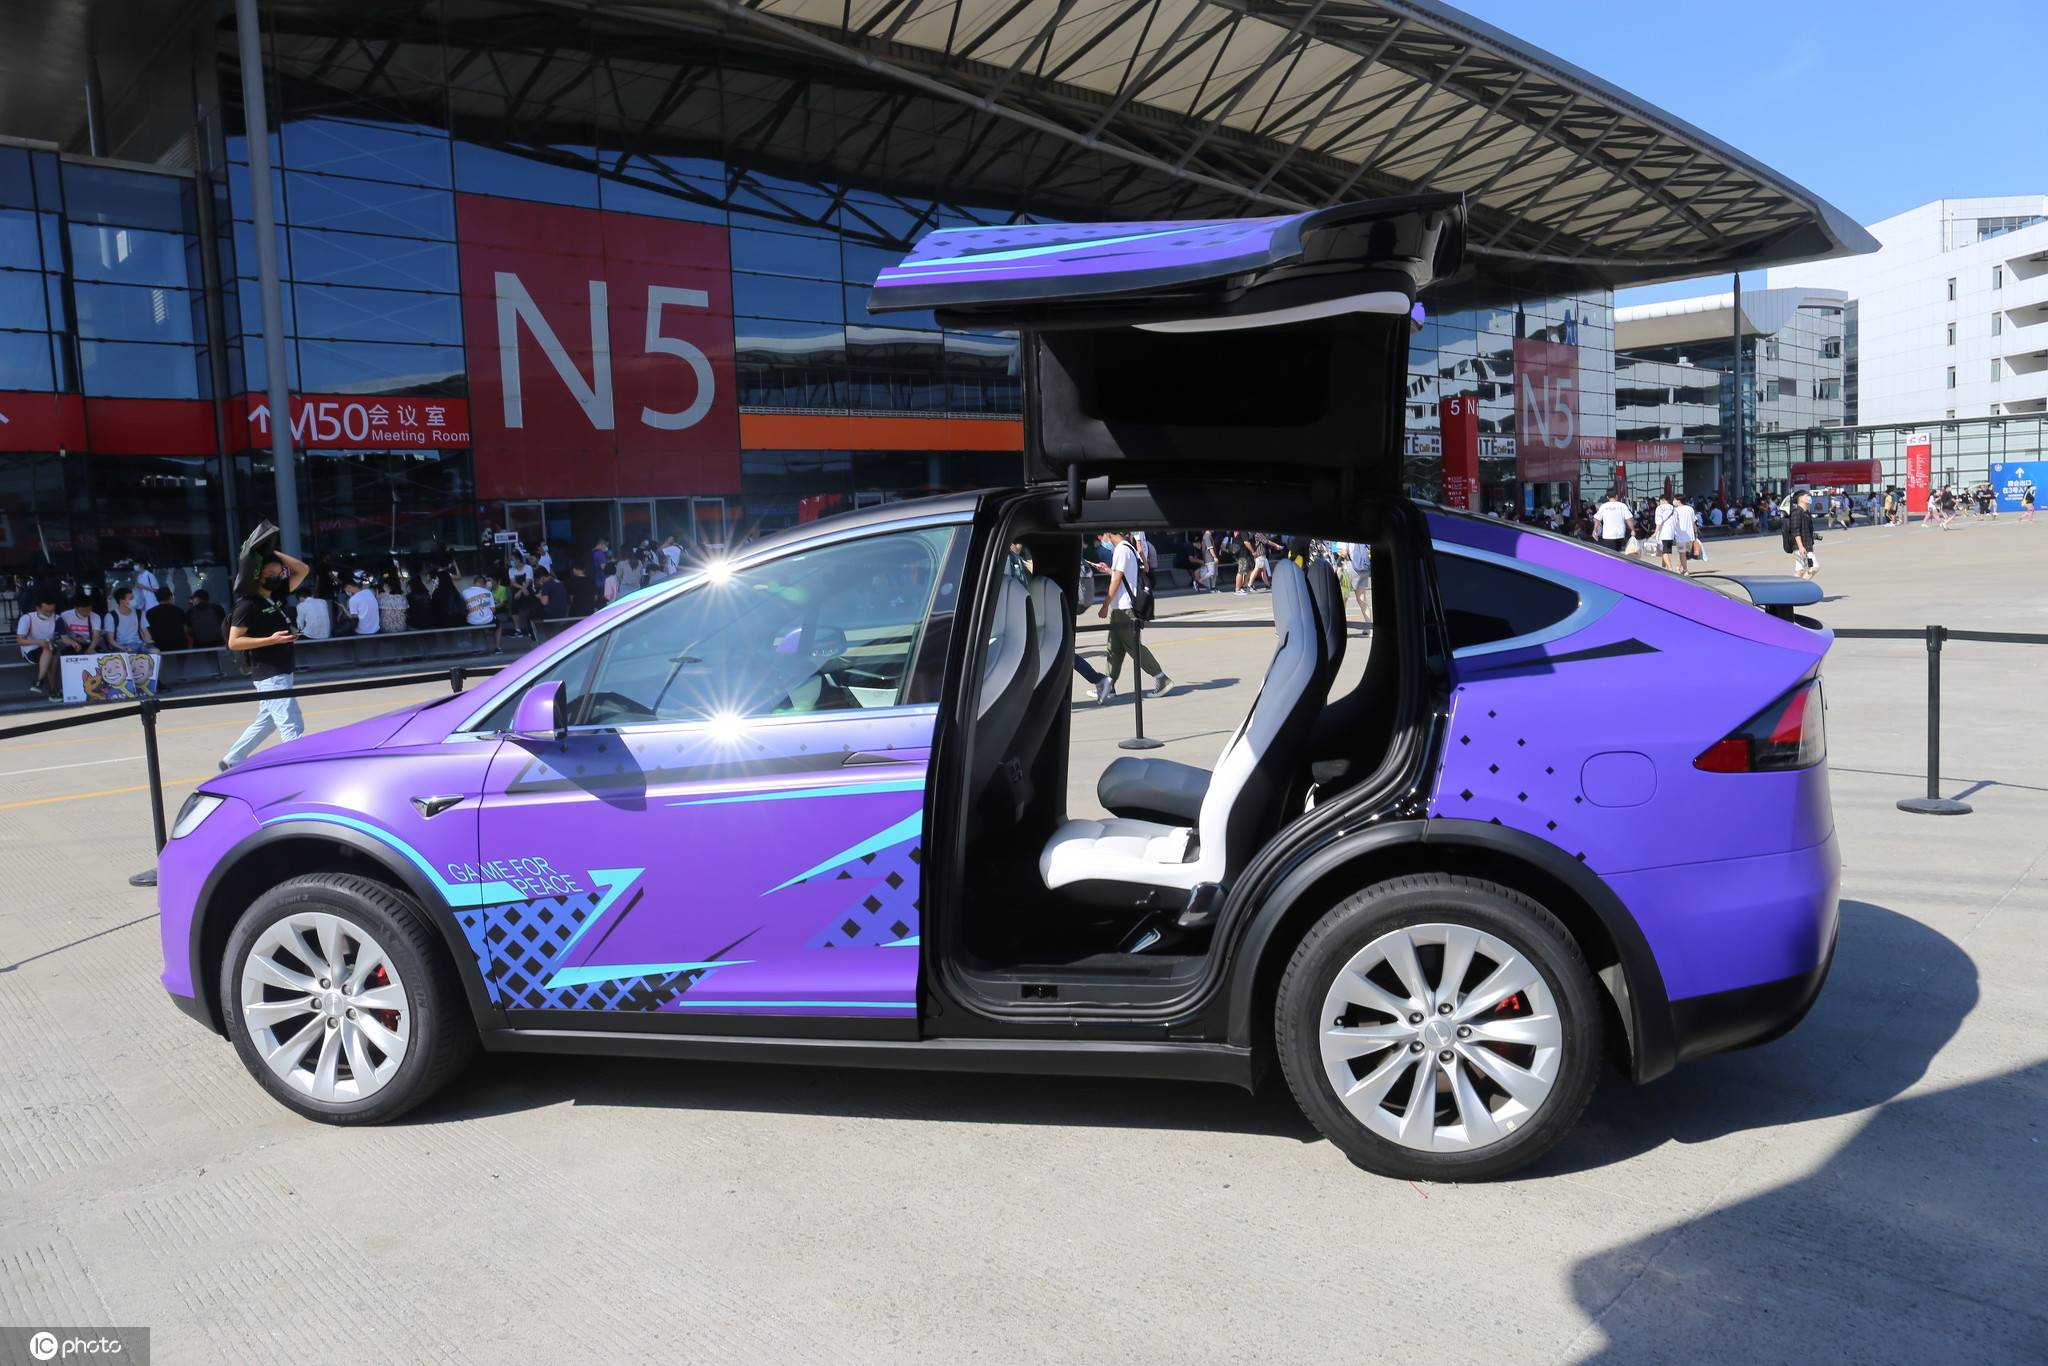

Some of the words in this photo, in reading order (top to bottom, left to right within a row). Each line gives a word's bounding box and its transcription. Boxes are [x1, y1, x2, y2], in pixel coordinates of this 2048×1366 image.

[494, 271, 715, 430] N5
[290, 402, 369, 441] M50
[369, 404, 446, 426] 会议室
[1522, 373, 1574, 449] N5
[372, 429, 425, 443] Meeting
[433, 430, 470, 441] Room
[447, 861, 516, 882] GAME
[509, 857, 560, 876] FOR
[512, 874, 583, 896] PEACE
